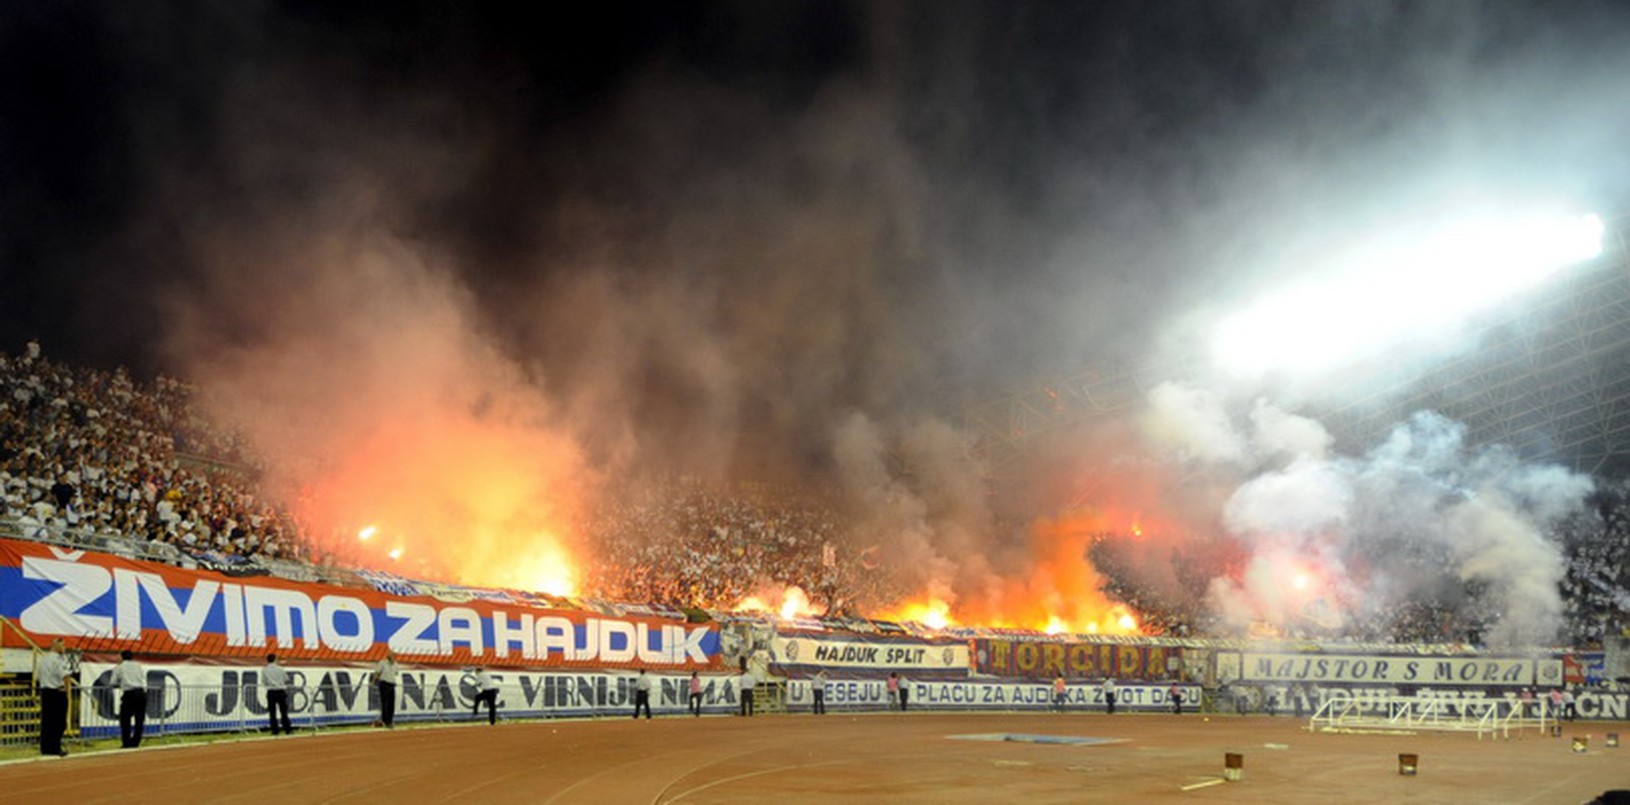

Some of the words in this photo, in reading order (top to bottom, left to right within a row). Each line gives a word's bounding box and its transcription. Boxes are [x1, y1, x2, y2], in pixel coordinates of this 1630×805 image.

[20, 547, 374, 653] ŽIVIMO
[386, 601, 483, 656] ZA
[492, 611, 710, 663] HAJDUK
[815, 646, 878, 663] HAJDUK
[886, 647, 925, 663] SPLIT
[990, 640, 1166, 673] TORCIDA
[1255, 658, 1388, 679] MAJSTOR
[1404, 661, 1419, 680] S
[1434, 662, 1522, 681] MORA
[92, 669, 181, 720] OD
[791, 682, 803, 702] U
[824, 682, 881, 702] ESEJU
[982, 686, 1005, 702] ZA
